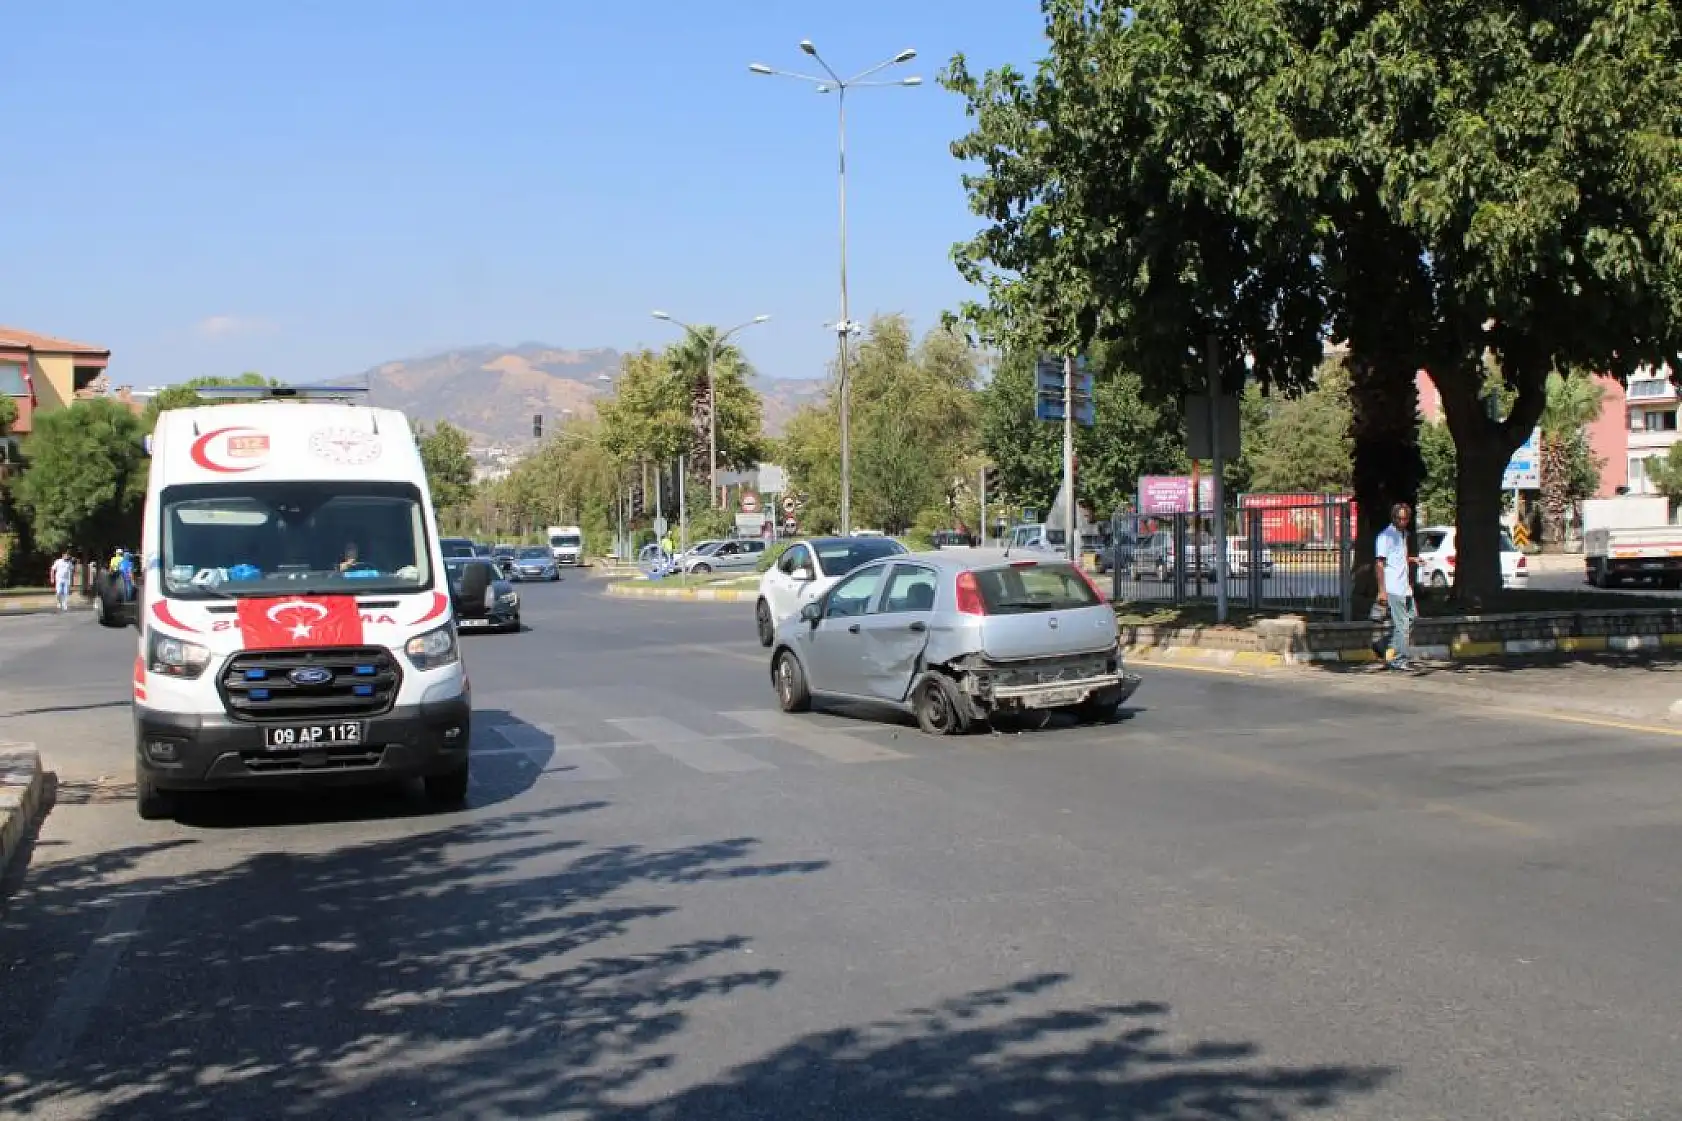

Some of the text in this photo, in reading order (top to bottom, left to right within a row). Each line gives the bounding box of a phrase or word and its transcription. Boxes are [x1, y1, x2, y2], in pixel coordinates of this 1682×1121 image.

[274, 724, 356, 744] 09 AP 112
